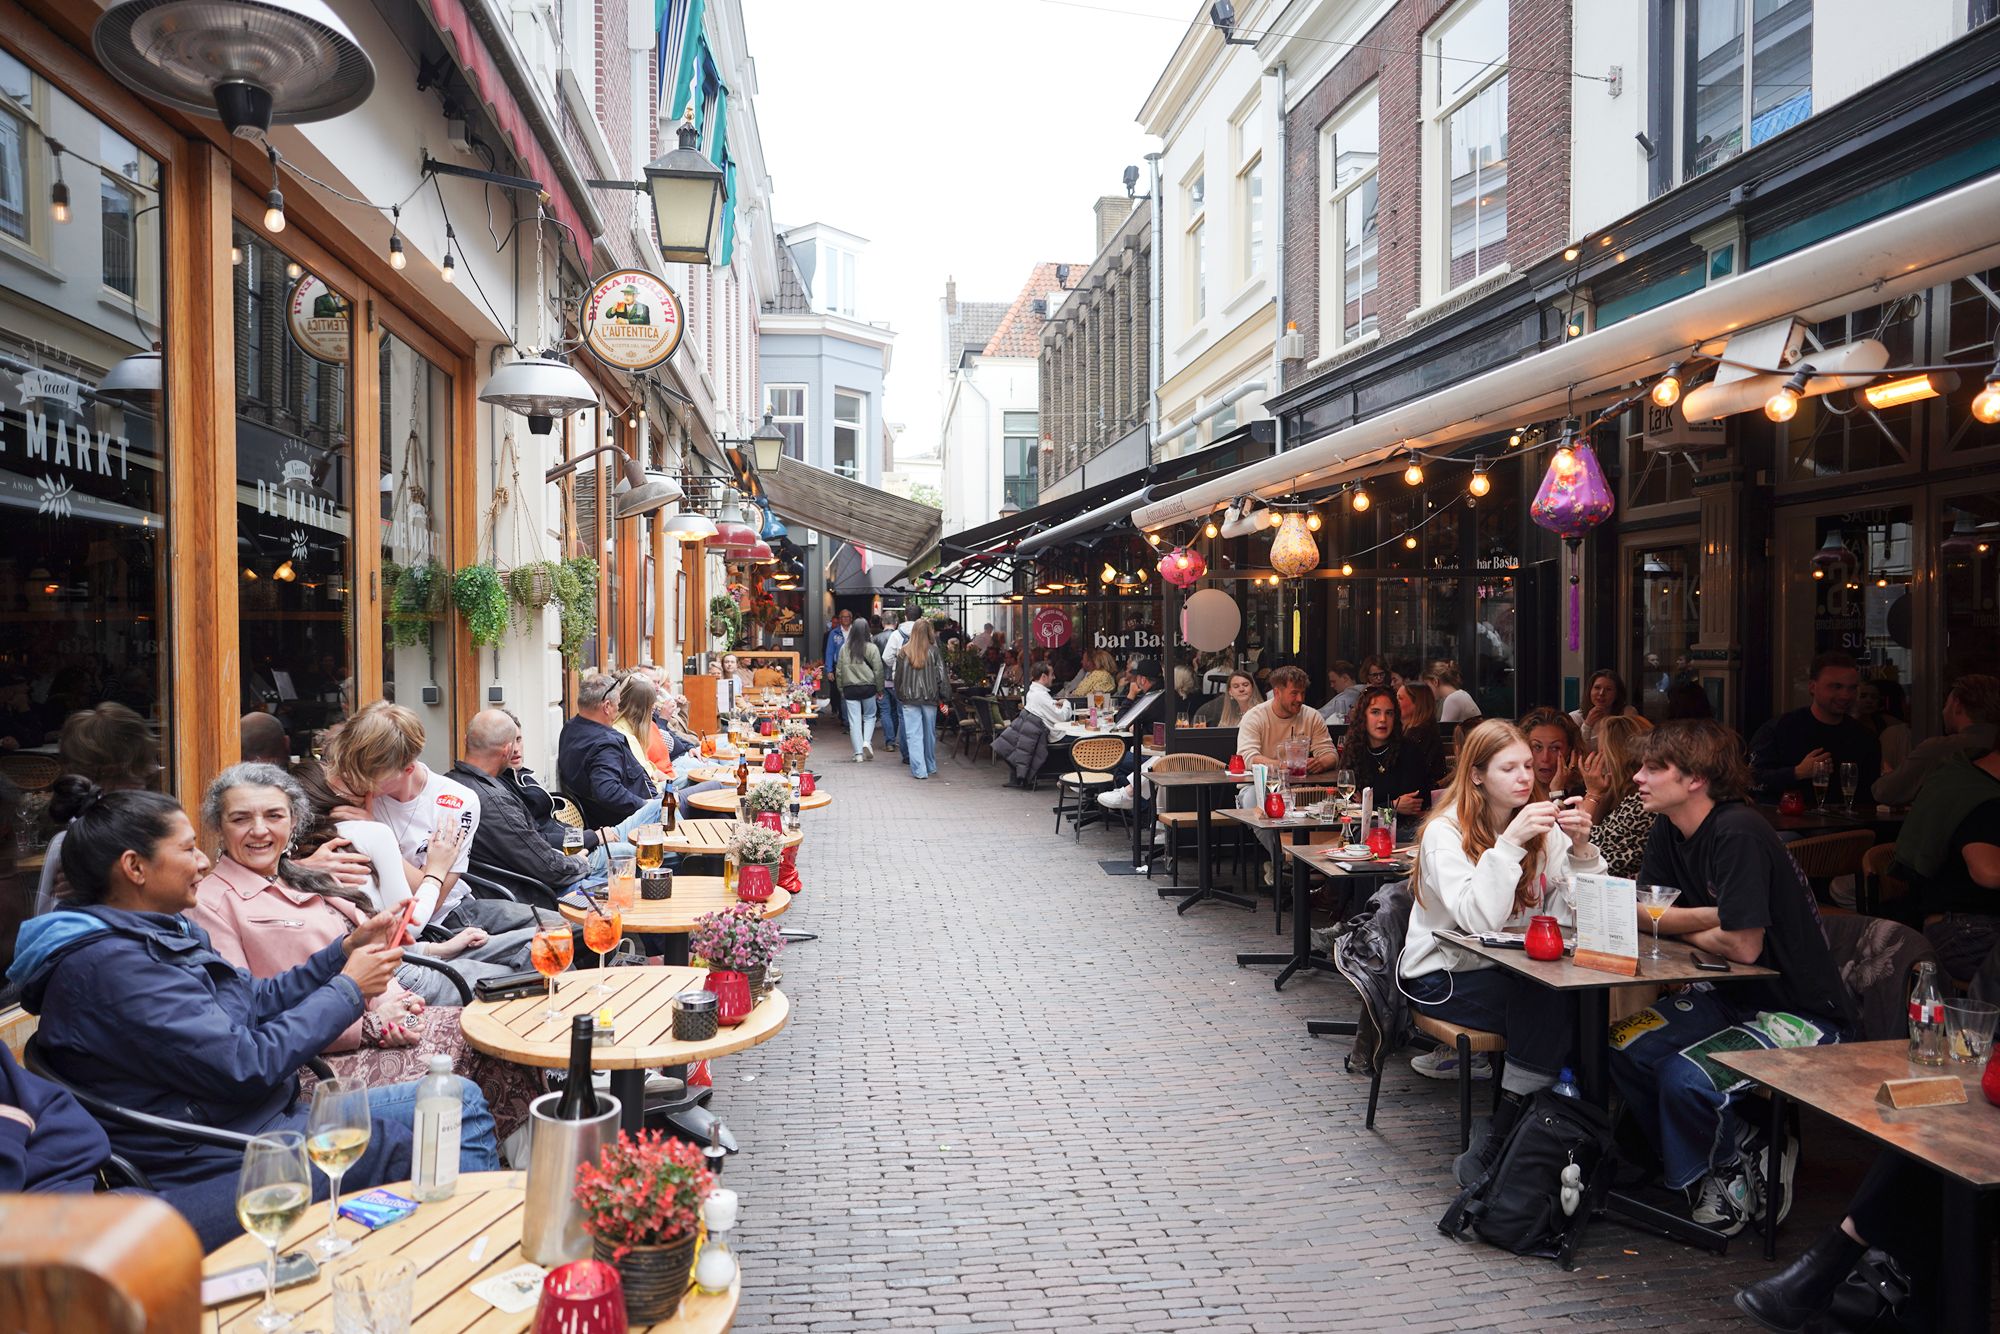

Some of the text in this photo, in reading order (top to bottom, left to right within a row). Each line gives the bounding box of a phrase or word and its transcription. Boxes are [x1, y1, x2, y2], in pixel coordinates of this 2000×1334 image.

[588, 275, 675, 324] BIRRA MORETTI
[602, 326, 659, 339] L'AUTENTICA
[26, 409, 130, 481] MARKT
[12, 481, 34, 493] ANNO
[257, 478, 335, 530] DE MARKT
[1093, 630, 1130, 648] bar
[438, 798, 461, 808] SEARA
